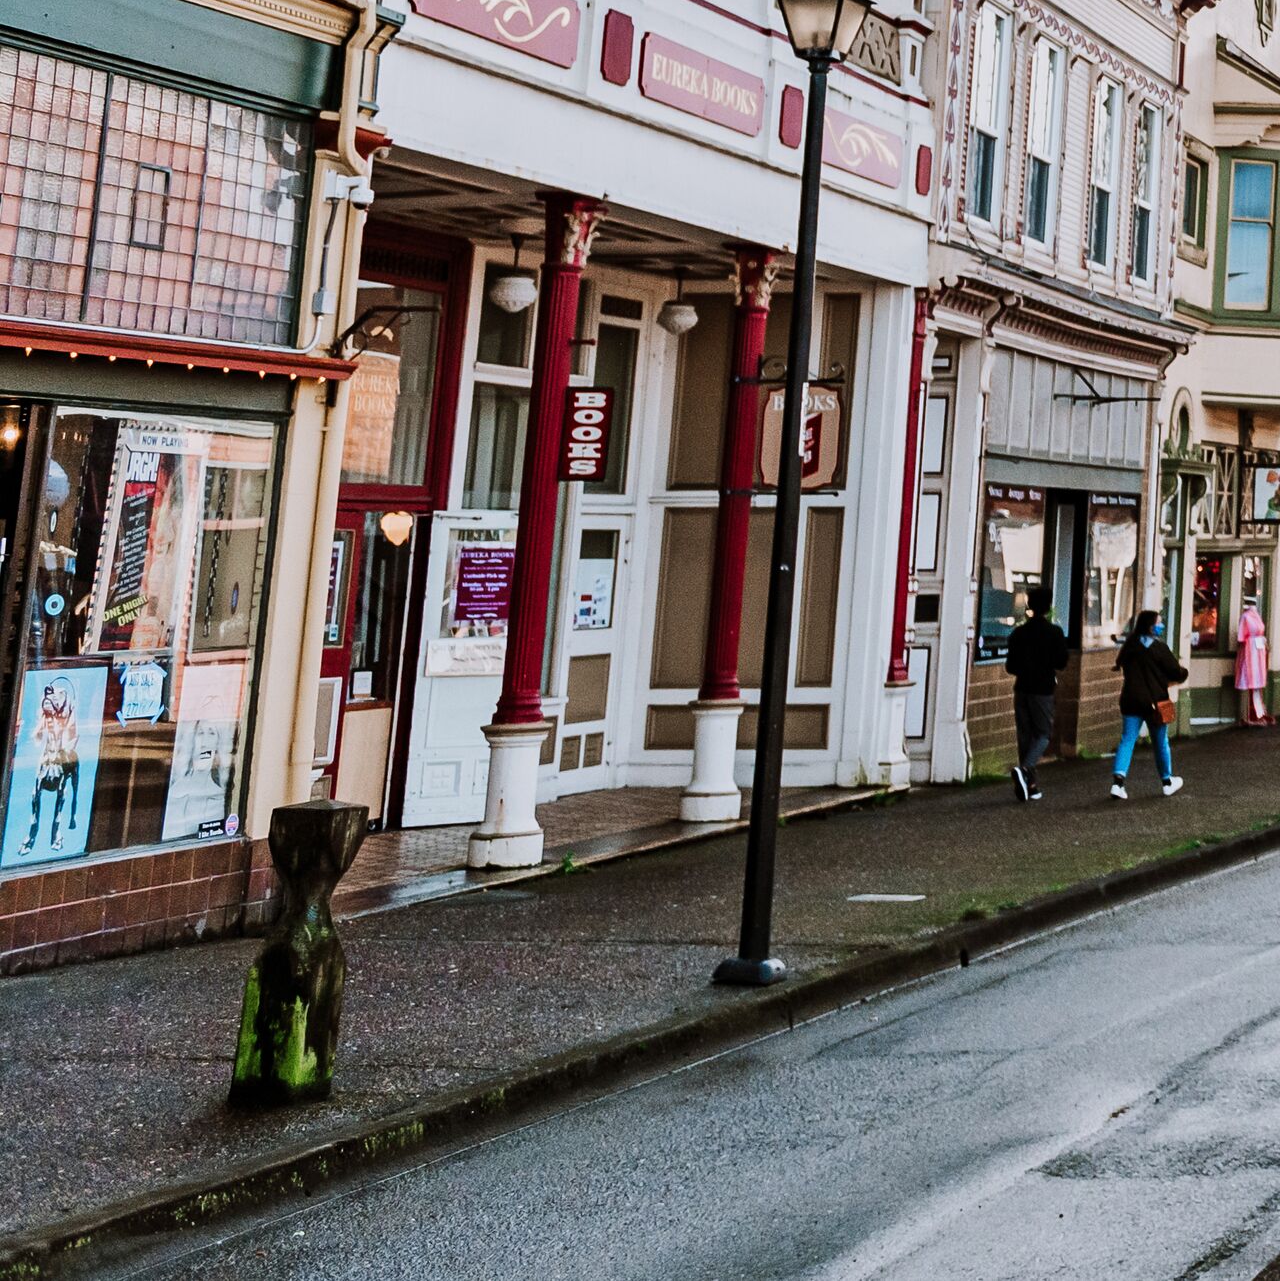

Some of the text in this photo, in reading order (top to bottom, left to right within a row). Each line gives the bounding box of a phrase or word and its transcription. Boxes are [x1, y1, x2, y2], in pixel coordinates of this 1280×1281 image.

[652, 52, 757, 117] EUREKA BOOKS
[773, 395, 836, 411] BKS
[142, 436, 157, 446] NOW
[567, 392, 607, 475] BOOKS
[103, 595, 148, 622] ONE NIGHT
[117, 608, 140, 626] ONLY
